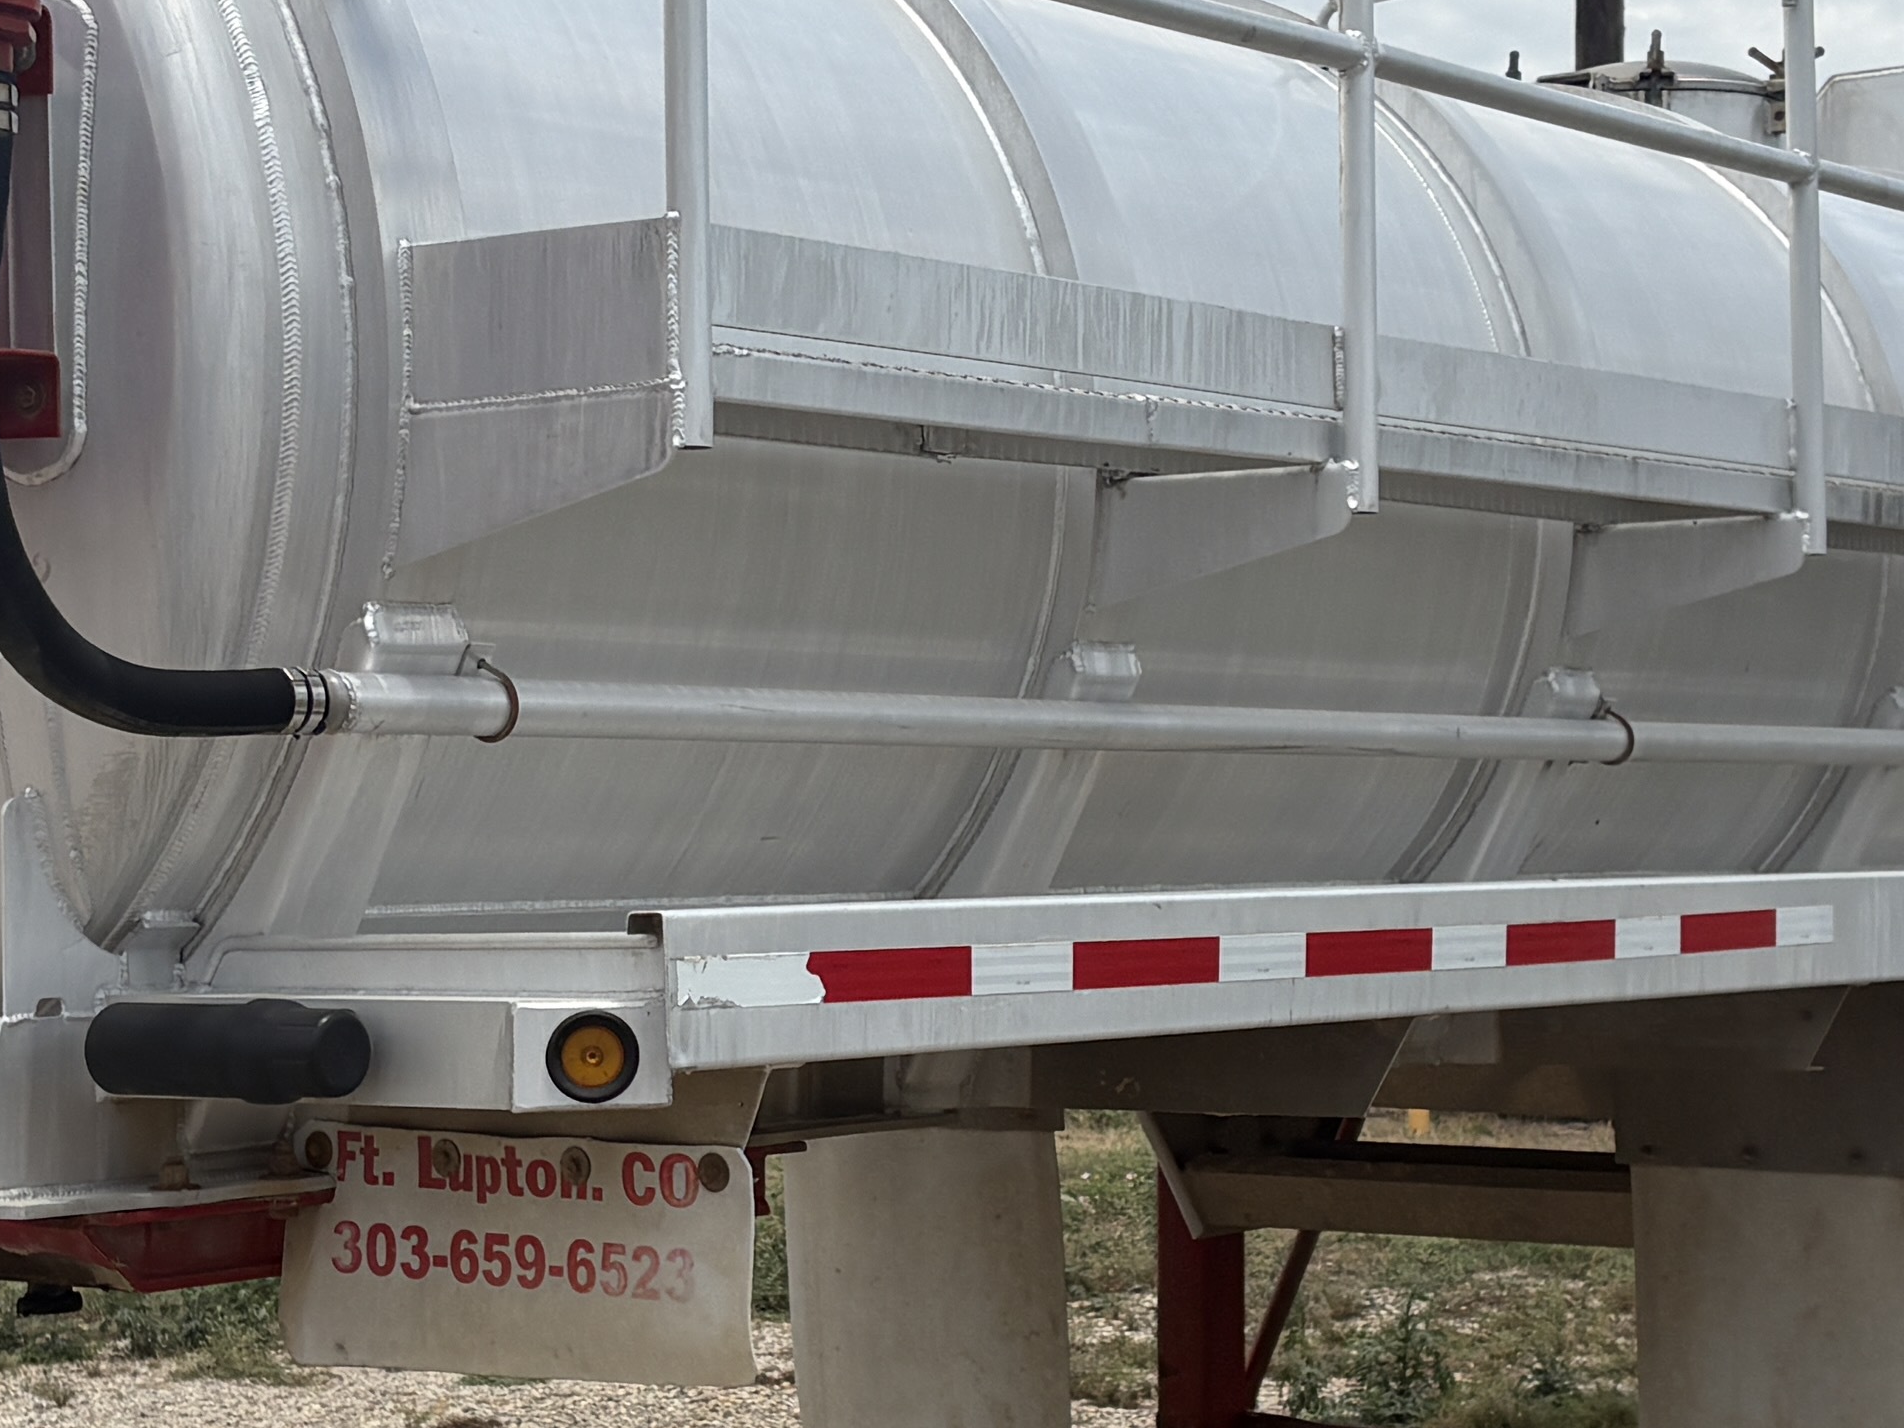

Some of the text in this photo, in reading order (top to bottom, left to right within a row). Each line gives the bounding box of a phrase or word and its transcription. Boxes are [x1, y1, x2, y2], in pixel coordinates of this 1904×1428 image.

[337, 1130, 395, 1186] Ft.
[621, 1151, 700, 1209] CO
[330, 1219, 695, 1305] 303-659-6523
